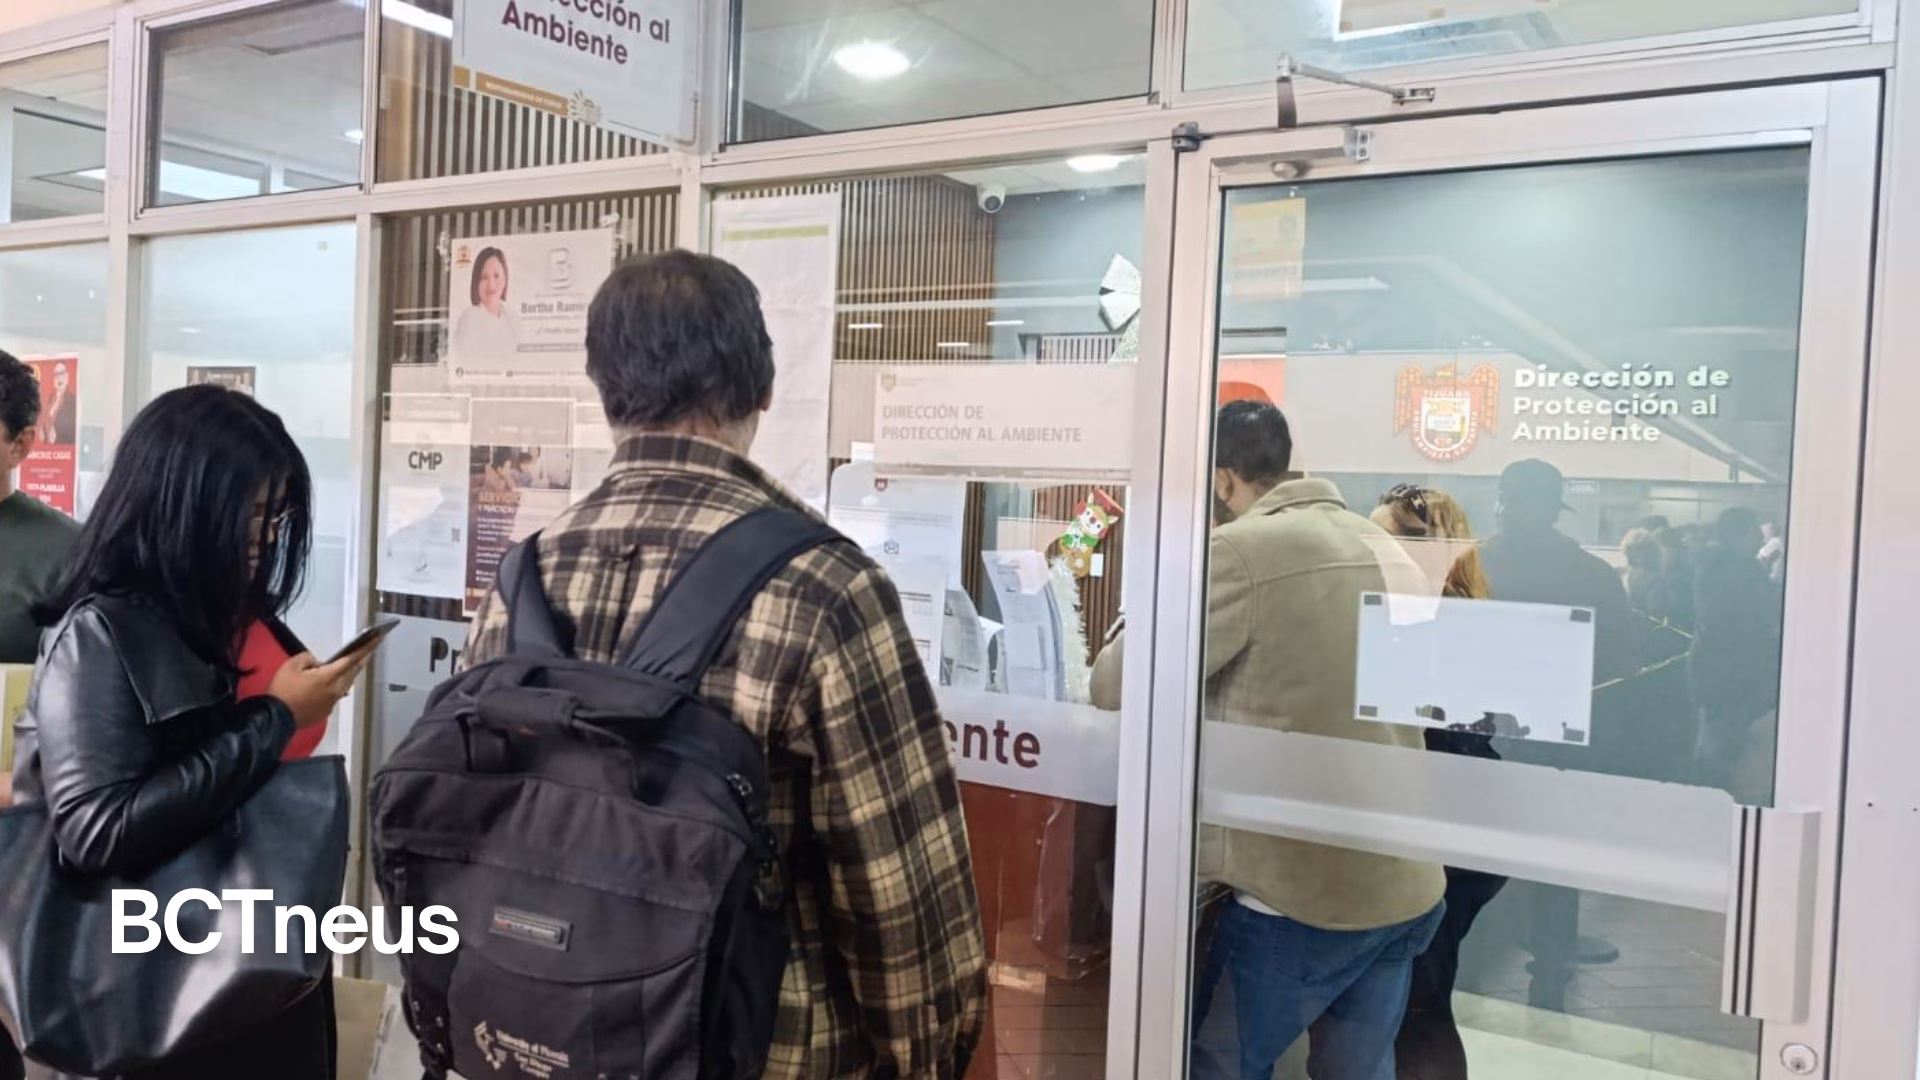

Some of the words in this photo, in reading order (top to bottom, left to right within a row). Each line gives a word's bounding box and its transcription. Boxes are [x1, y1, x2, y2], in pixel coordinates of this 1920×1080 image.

[502, 0, 628, 65] Ambiente
[551, 0, 642, 33] cción
[649, 18, 670, 43] al
[1513, 362, 1675, 388] Dirección
[1687, 365, 1730, 387] de
[882, 402, 959, 420] DIRECCIÓN
[964, 405, 984, 420] DE
[1513, 392, 1679, 416] Protección
[1691, 394, 1718, 415] al
[881, 424, 973, 440] PROTECCIÓN
[976, 426, 995, 441] AL
[1001, 427, 1083, 443] AMBIENTE
[1512, 419, 1661, 442] Ambiente
[408, 450, 443, 471] CMP
